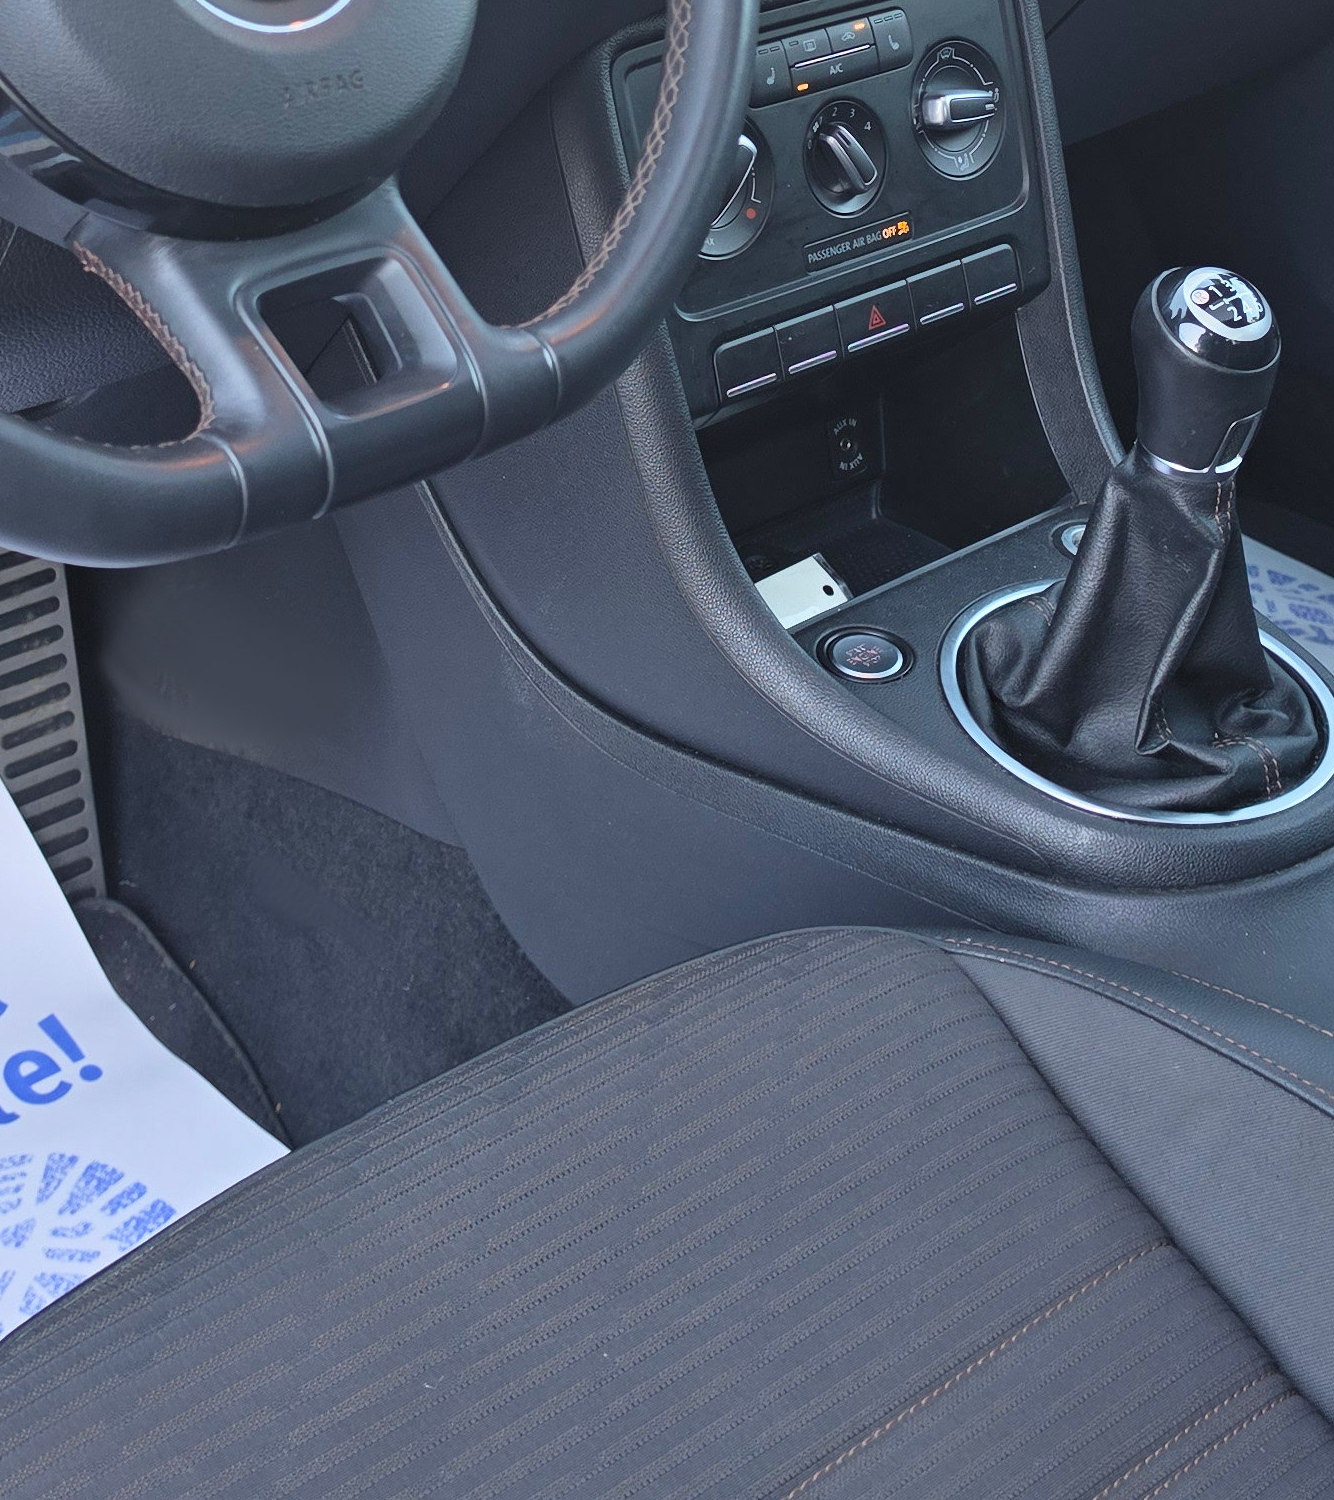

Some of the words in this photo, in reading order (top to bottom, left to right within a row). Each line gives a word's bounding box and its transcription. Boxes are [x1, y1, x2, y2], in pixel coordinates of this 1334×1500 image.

[829, 63, 844, 75] A/C
[831, 107, 838, 117] 2
[849, 108, 856, 118] 3
[863, 121, 872, 131] 4
[807, 241, 852, 264] PASSENGER
[852, 236, 866, 249] AIR
[865, 231, 882, 244] BAG
[882, 225, 897, 239] OFF
[1227, 306, 1244, 322] 2
[833, 418, 848, 436] AUX
[849, 452, 863, 470] AUX
